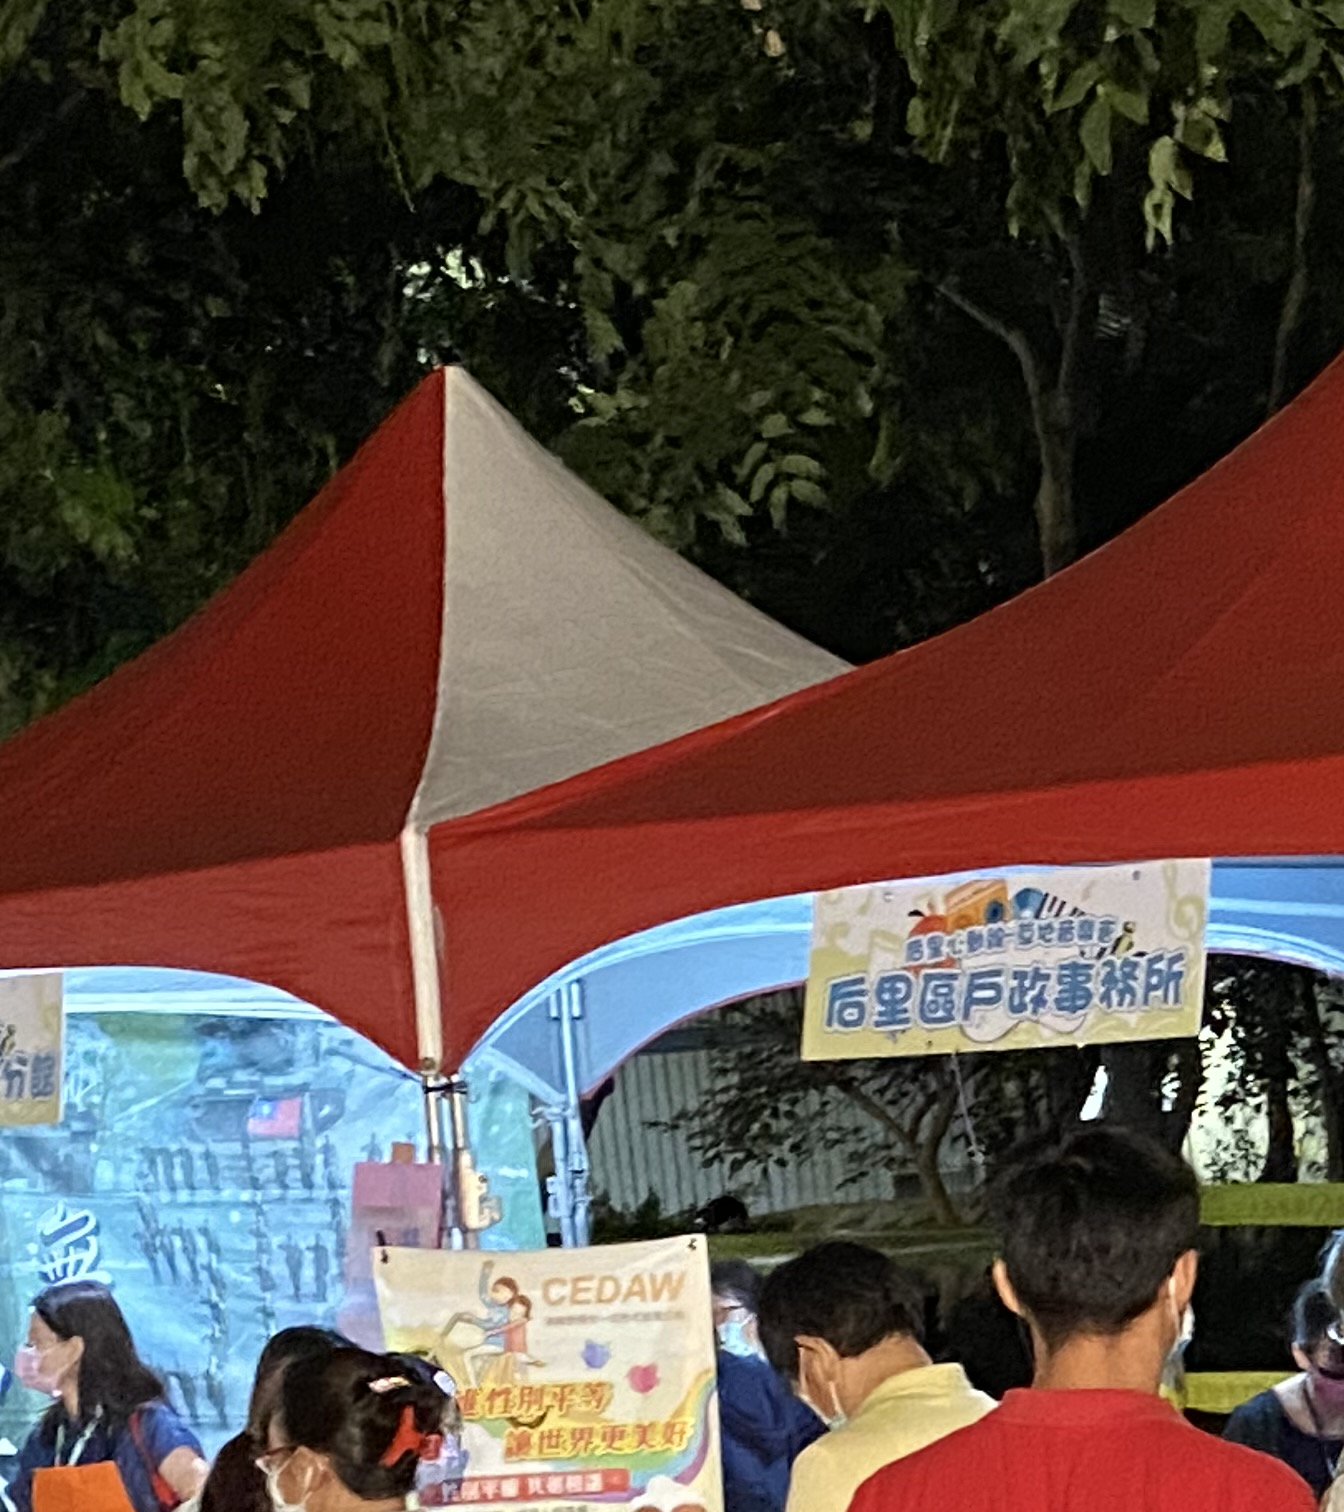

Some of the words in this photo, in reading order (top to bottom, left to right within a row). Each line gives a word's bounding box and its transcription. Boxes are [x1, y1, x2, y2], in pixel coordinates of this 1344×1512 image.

[824, 953, 1186, 1029] 后里區戶政事務所
[541, 1270, 688, 1306] CEDAW
[505, 1419, 689, 1458] 讓世界更美好
